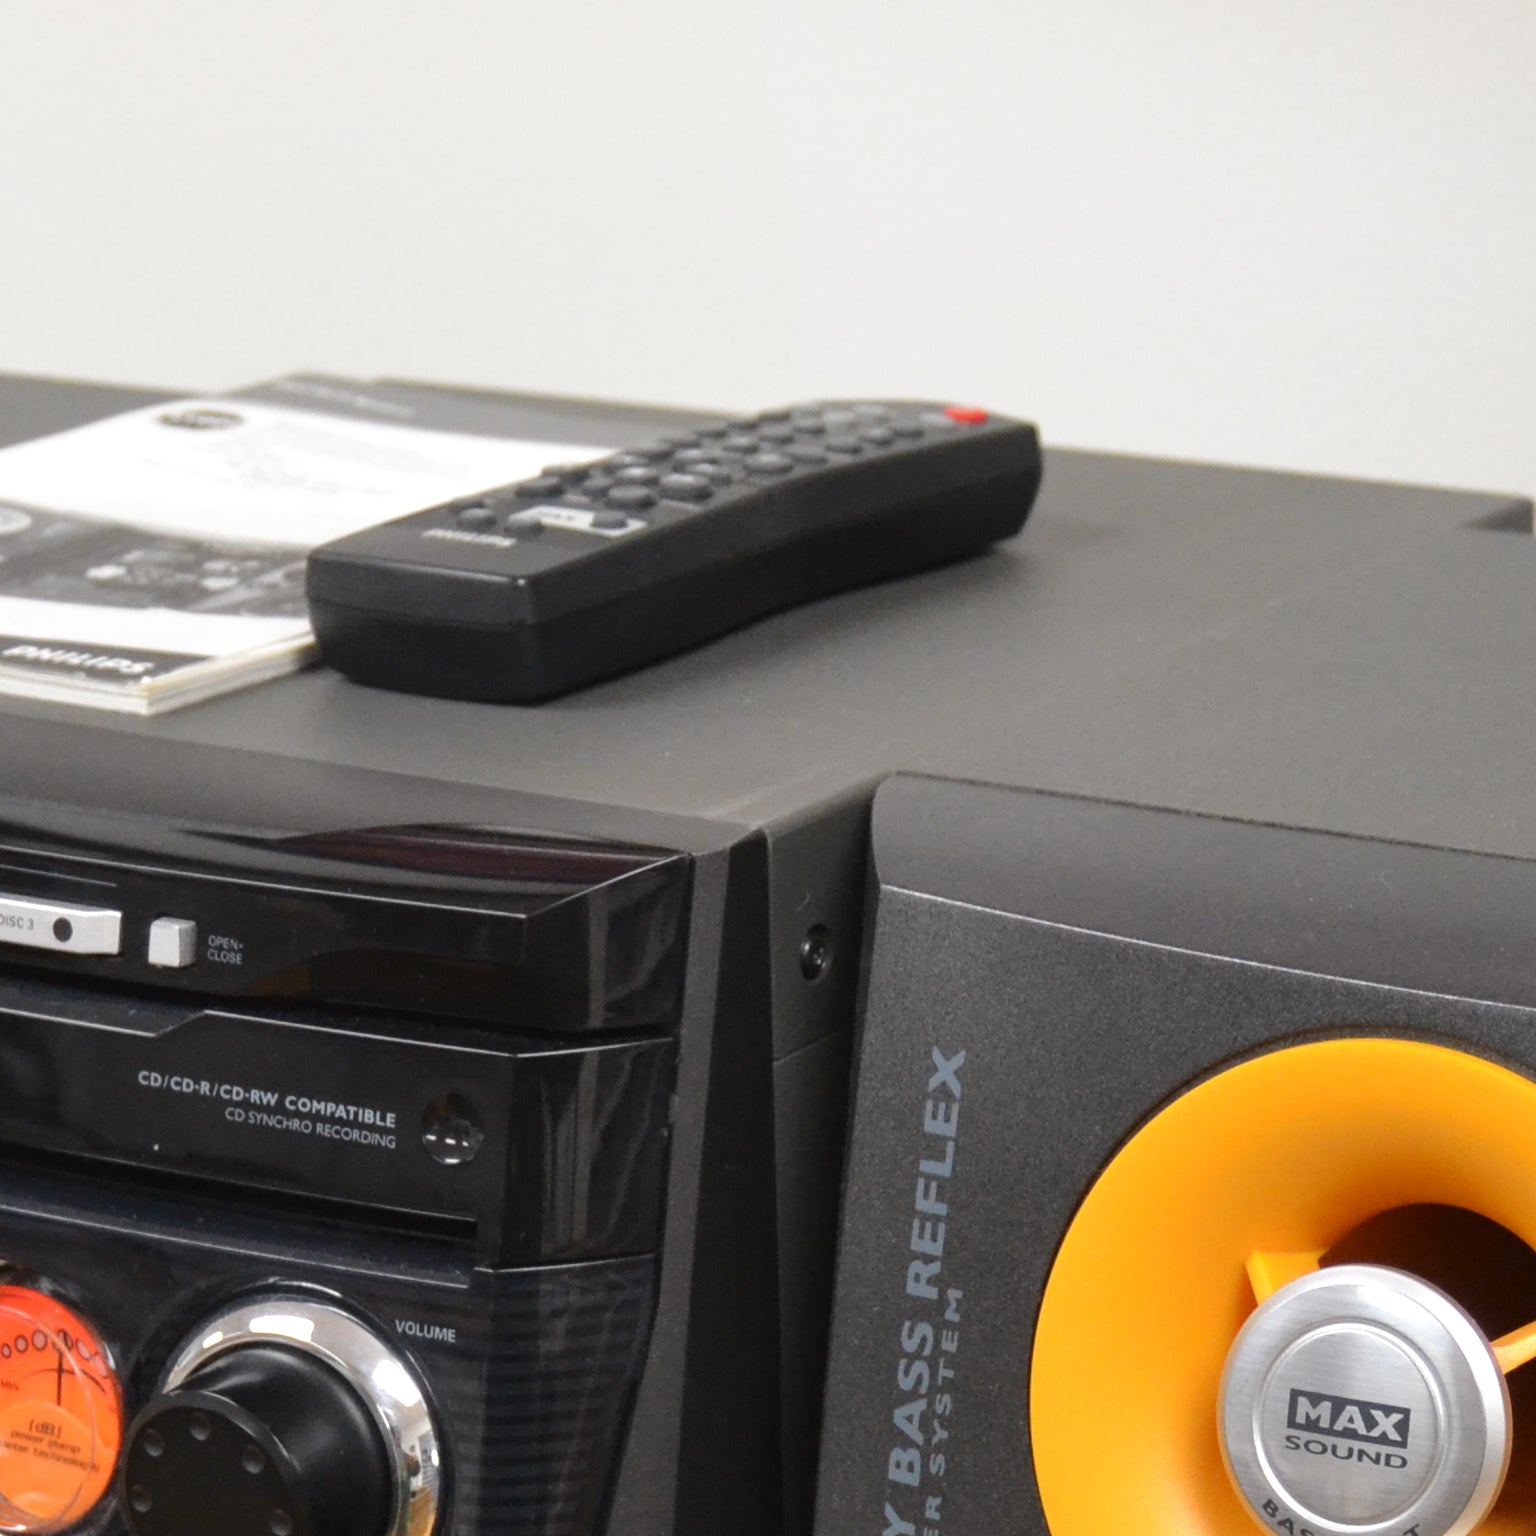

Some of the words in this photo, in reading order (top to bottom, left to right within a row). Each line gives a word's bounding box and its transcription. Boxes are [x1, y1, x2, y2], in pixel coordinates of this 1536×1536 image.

[26, 918, 35, 931] 3
[207, 948, 243, 966] CLOSE
[225, 1106, 246, 1122] CD
[248, 1113, 312, 1135] SYNCHRO
[315, 1122, 397, 1149] RECORDING
[285, 1095, 397, 1129] COMPATIBLE
[905, 1044, 967, 1301] REFLEX
[394, 1318, 457, 1344] VOLUME
[929, 1287, 964, 1478] SYSTEM
[888, 1318, 935, 1488] BASS
[1291, 1391, 1408, 1446] MAX
[1284, 1435, 1408, 1469] SOUND
